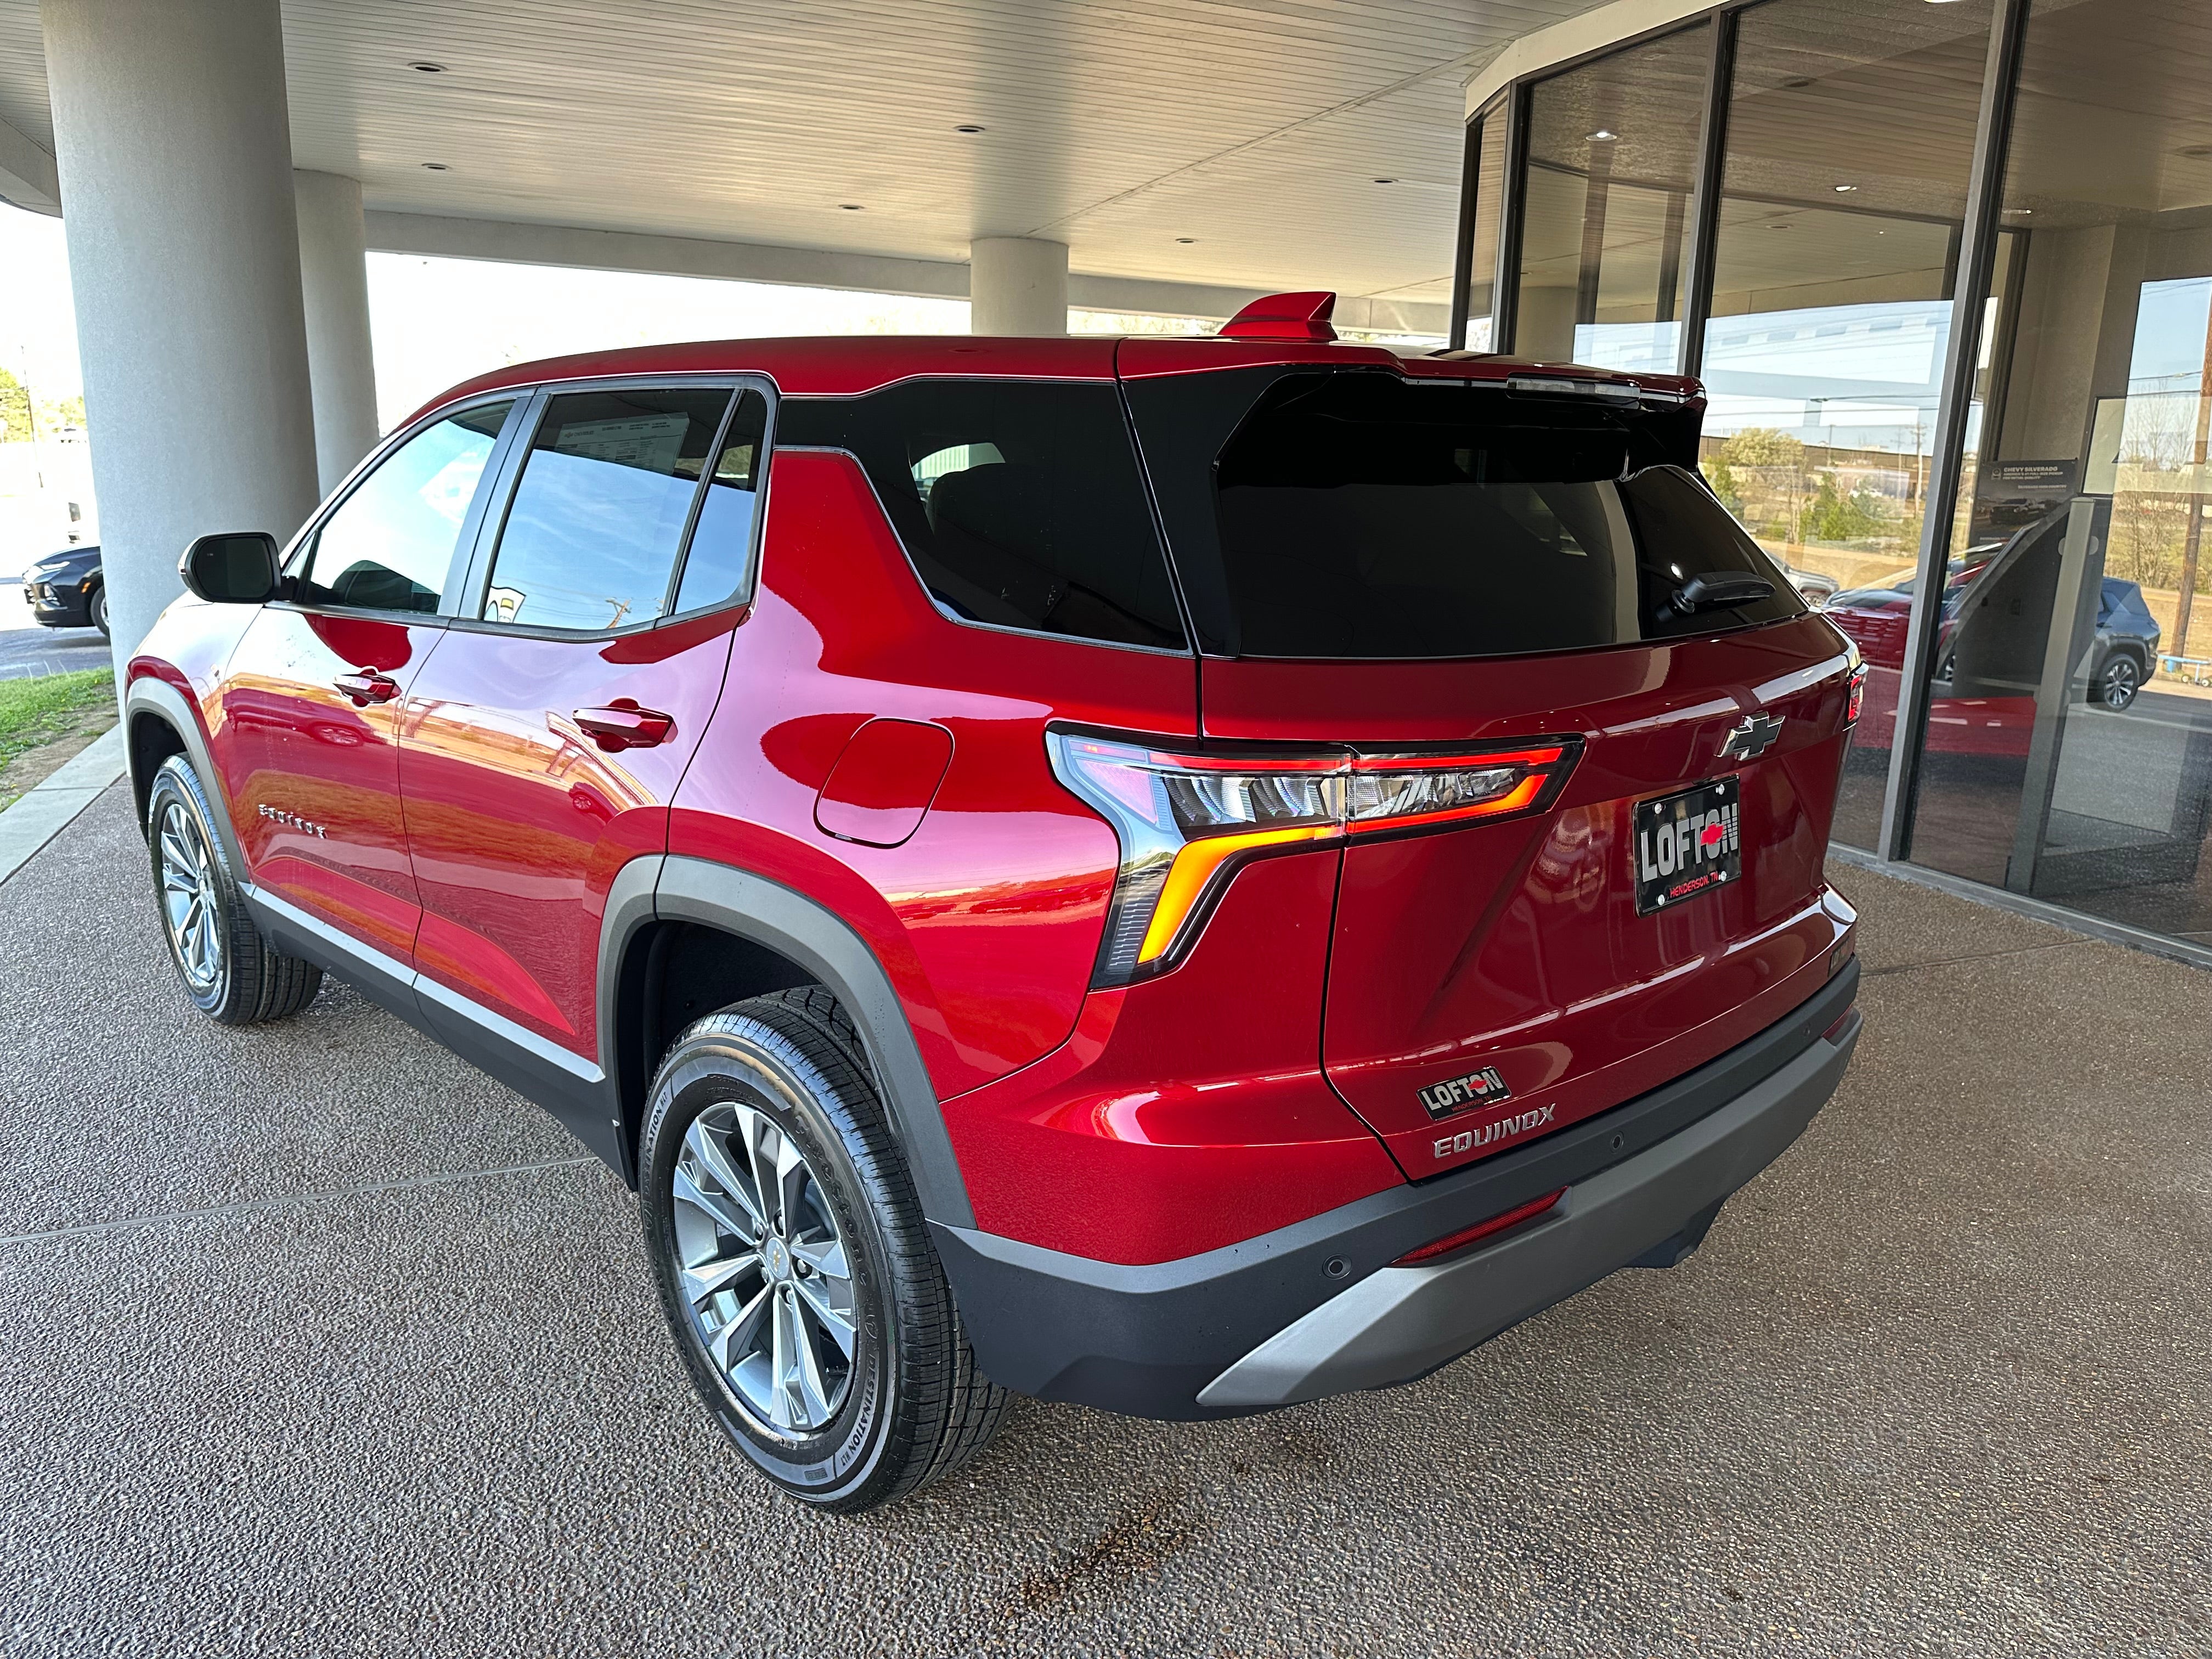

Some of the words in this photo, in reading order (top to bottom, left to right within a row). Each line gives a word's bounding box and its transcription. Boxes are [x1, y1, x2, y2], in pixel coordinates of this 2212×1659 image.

[1640, 802, 1739, 883] LOFTON
[1710, 871, 1719, 883] TN
[1421, 1069, 1504, 1111] LOFTON
[1432, 1103, 1556, 1159] EQUINOX
[848, 1353, 877, 1455] DESTINATION
